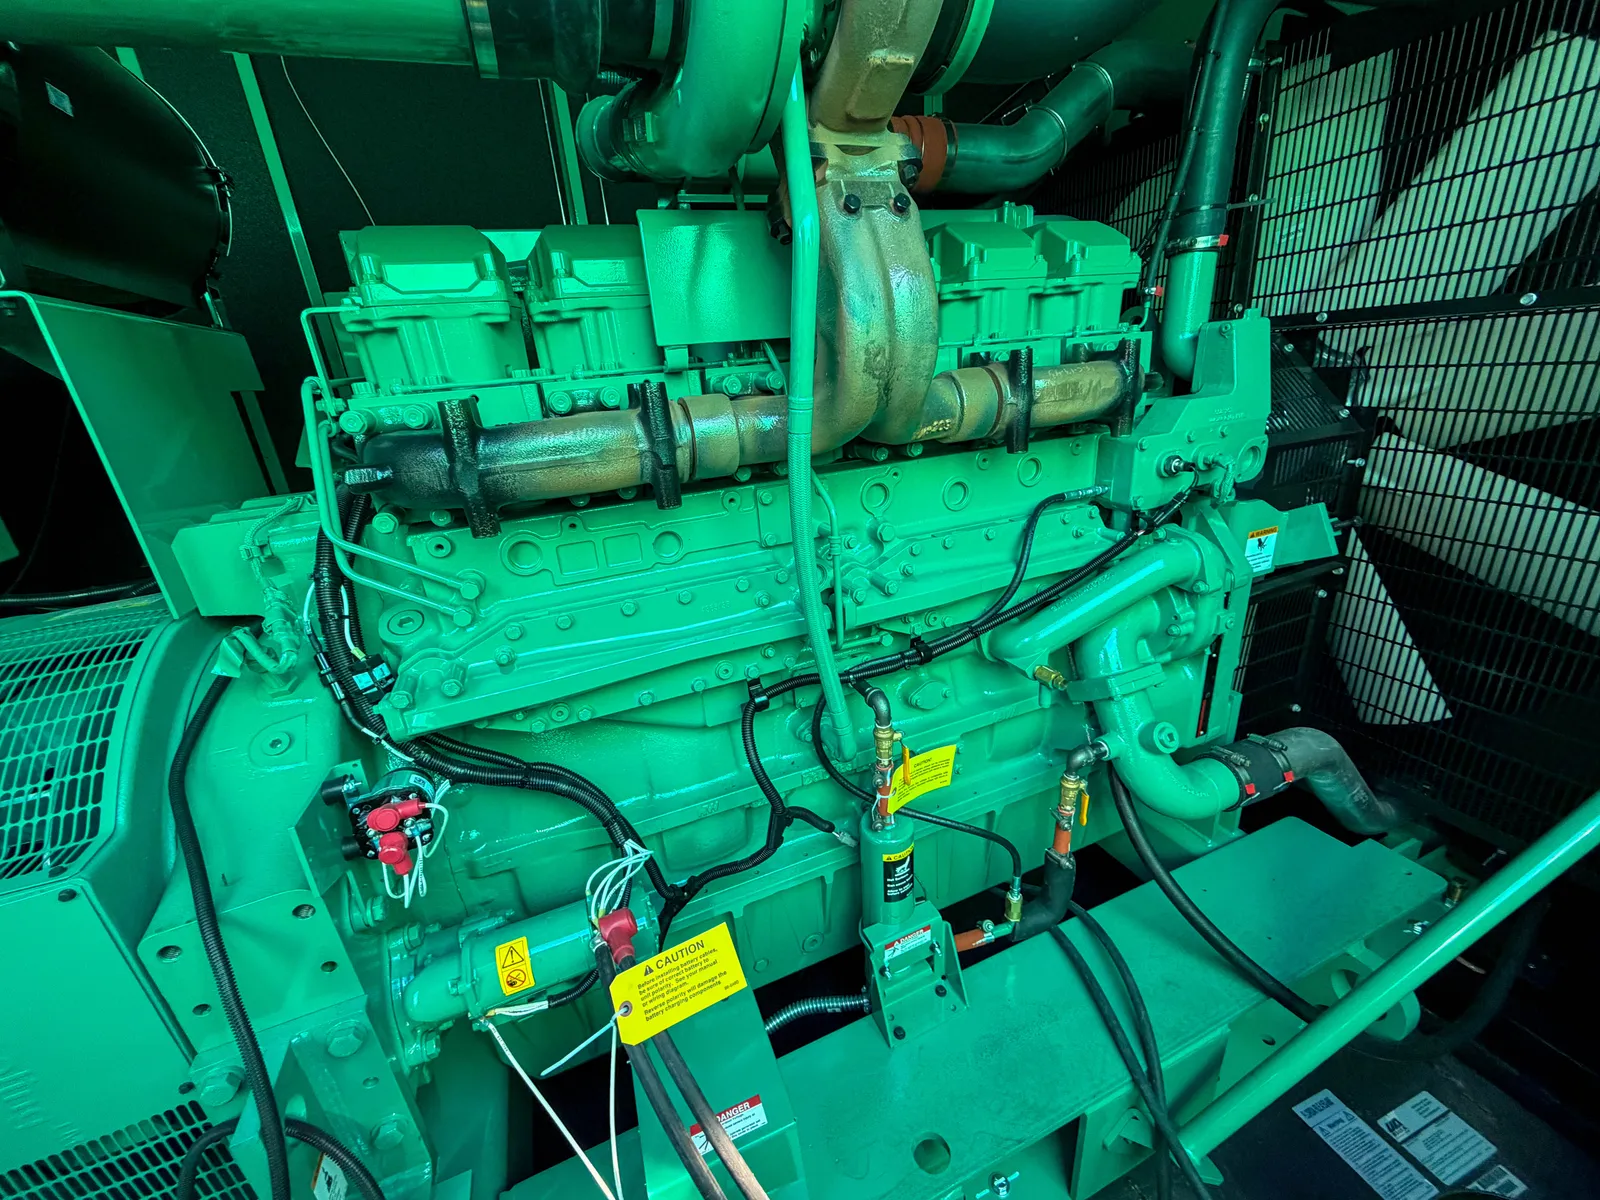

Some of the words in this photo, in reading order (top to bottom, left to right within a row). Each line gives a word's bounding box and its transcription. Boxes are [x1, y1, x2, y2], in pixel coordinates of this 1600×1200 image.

[901, 929, 924, 944] DANGER
[655, 939, 705, 969] CAUTION
[637, 977, 656, 990] Before
[655, 965, 681, 981] installing
[679, 956, 699, 970] battery
[640, 992, 652, 1002] unit
[651, 982, 674, 997] polarity.
[675, 976, 686, 984] See
[685, 969, 698, 980] your
[698, 959, 718, 973] manual
[646, 982, 659, 992] sure
[665, 969, 685, 983] correct
[684, 961, 703, 973] battery
[643, 1001, 666, 1016] Reverse
[666, 991, 687, 1006] polarity
[686, 985, 697, 994] will
[696, 975, 718, 989] damage
[717, 970, 728, 979] the
[645, 1008, 665, 1022] battery
[664, 996, 689, 1012] charging
[688, 980, 722, 1000] components
[648, 992, 666, 1004] wiring
[665, 981, 689, 996] diagram.
